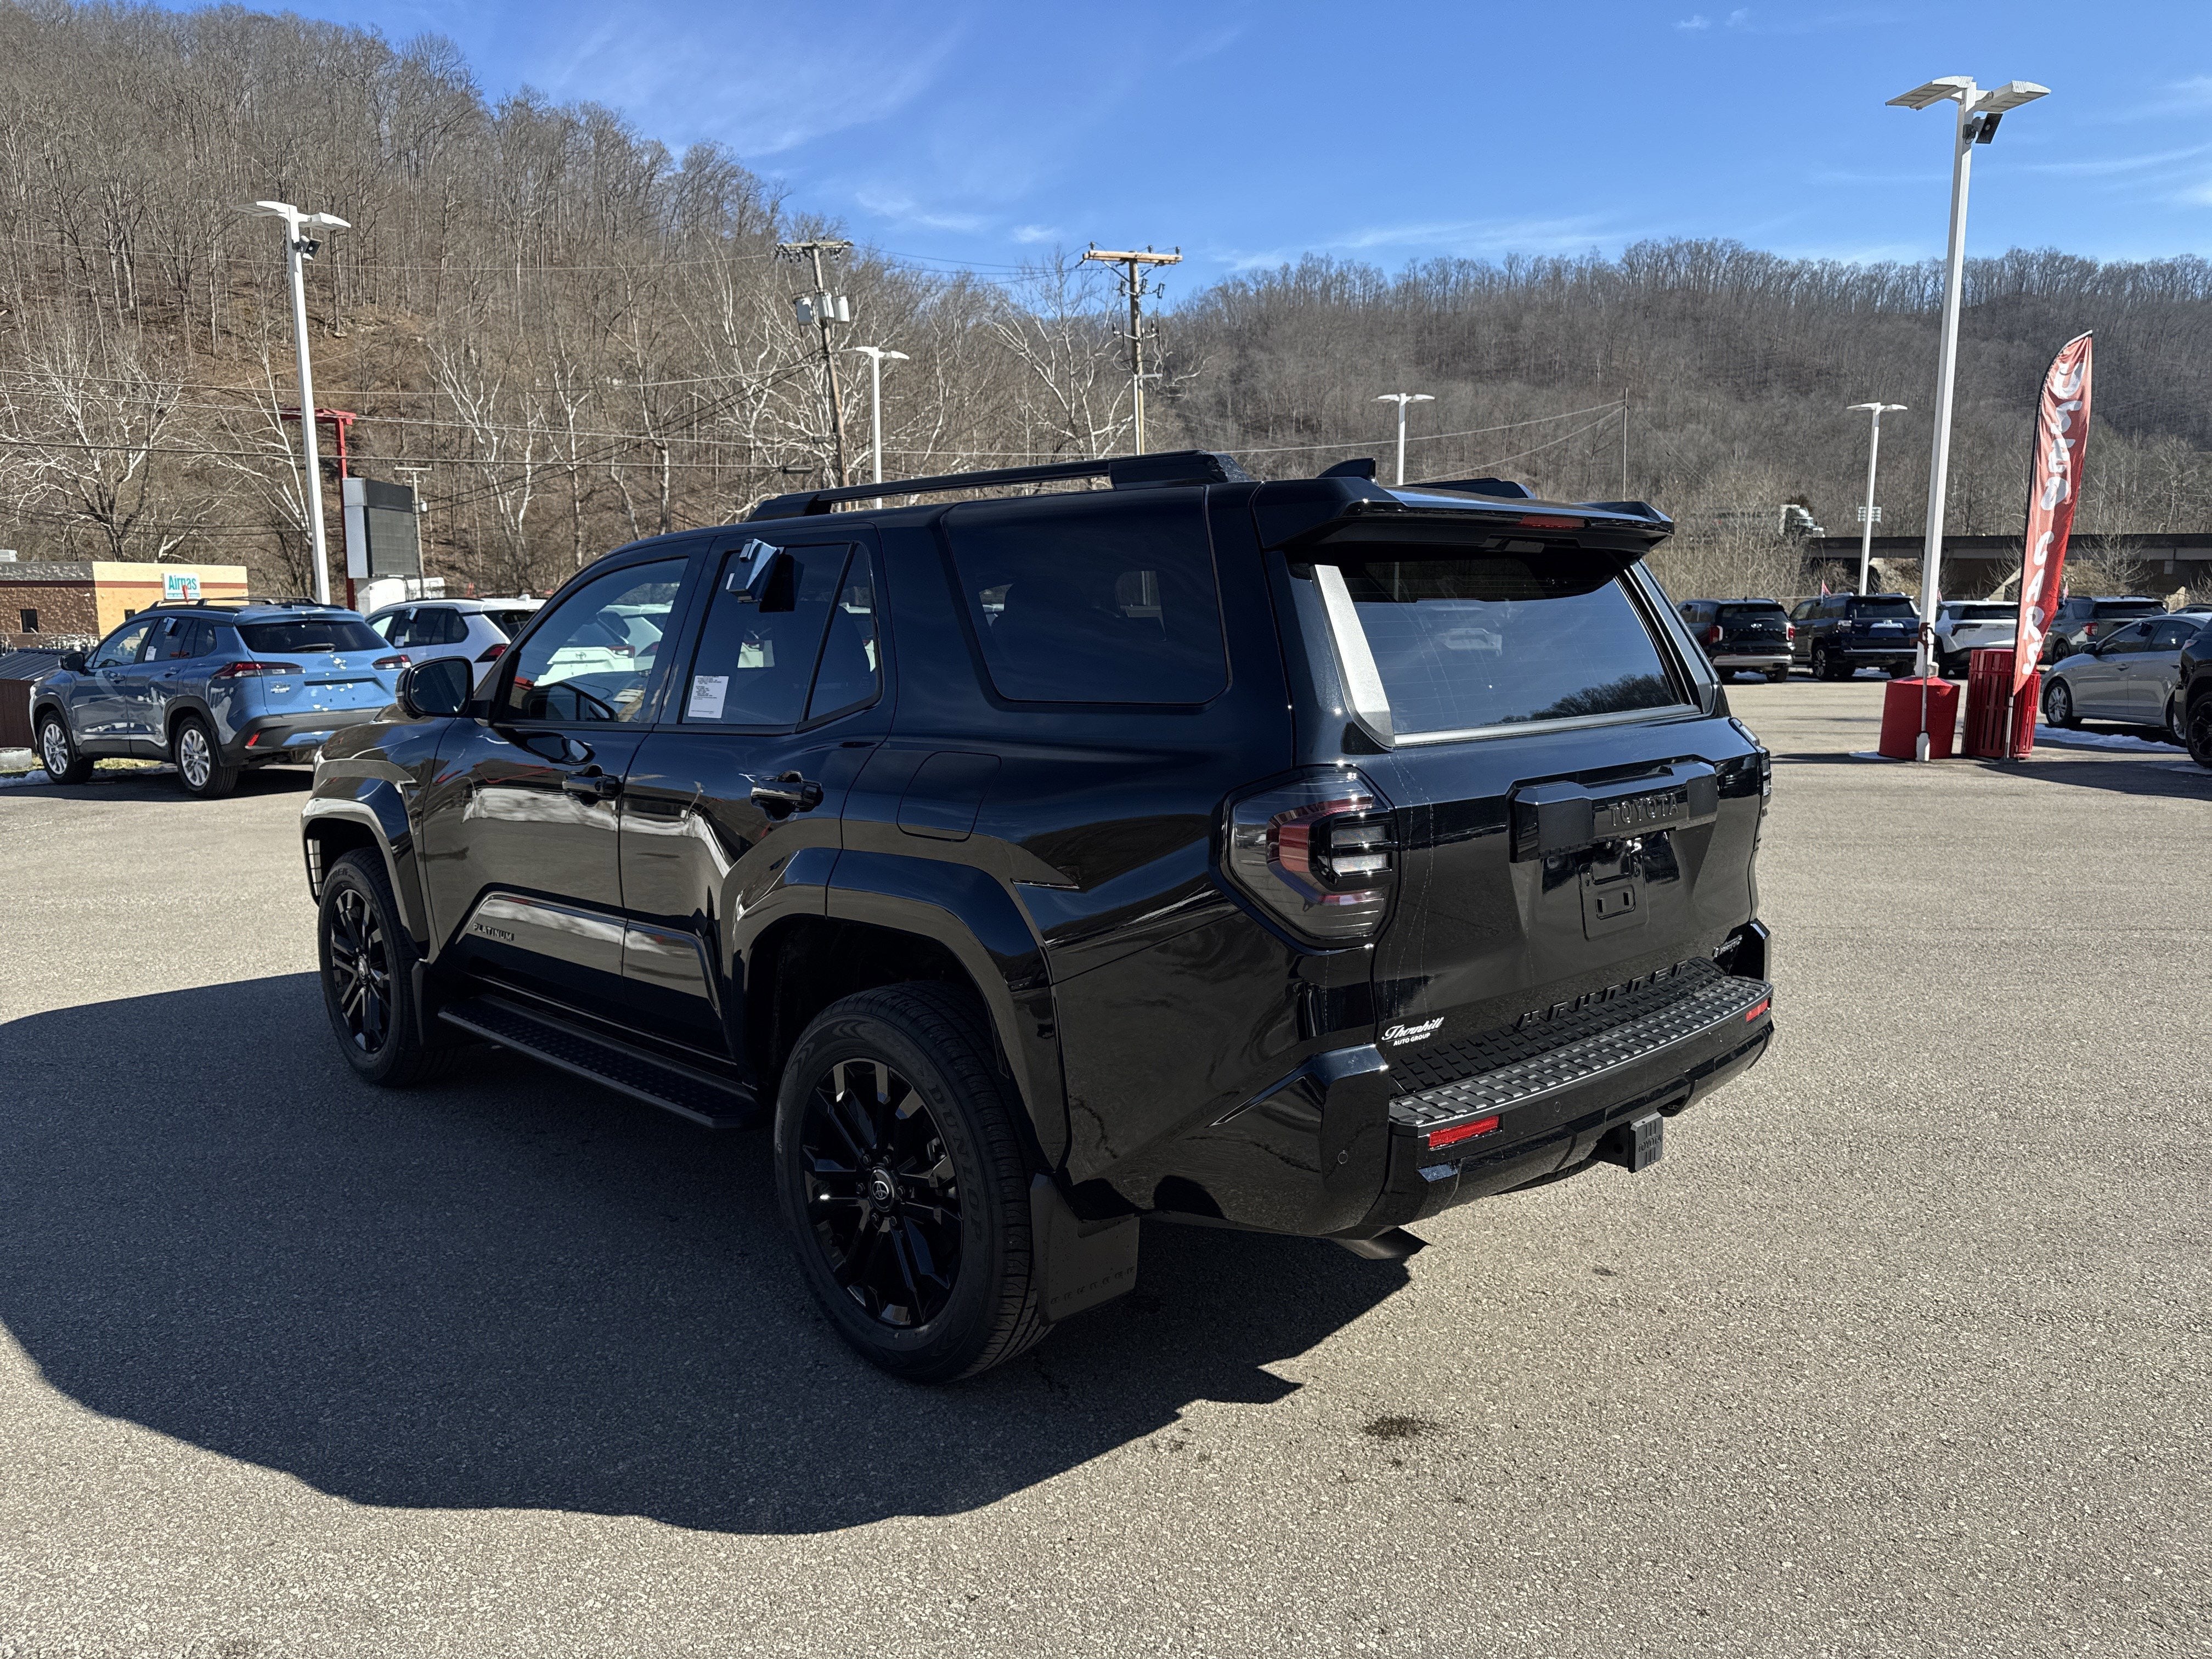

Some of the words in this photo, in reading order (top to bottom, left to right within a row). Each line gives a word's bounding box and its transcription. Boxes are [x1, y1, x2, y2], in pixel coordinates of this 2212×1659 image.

[2022, 531, 2055, 675] CARS
[1608, 793, 1678, 827] TOYOTA
[473, 922, 515, 942] PLATINUM
[1381, 1017, 1444, 1040] Thornhill
[1393, 1038, 1410, 1046] AUTO
[1410, 1032, 1431, 1042] GROUP
[1637, 1134, 1662, 1153] TOYOTA
[927, 1084, 982, 1242] DUNLOP
